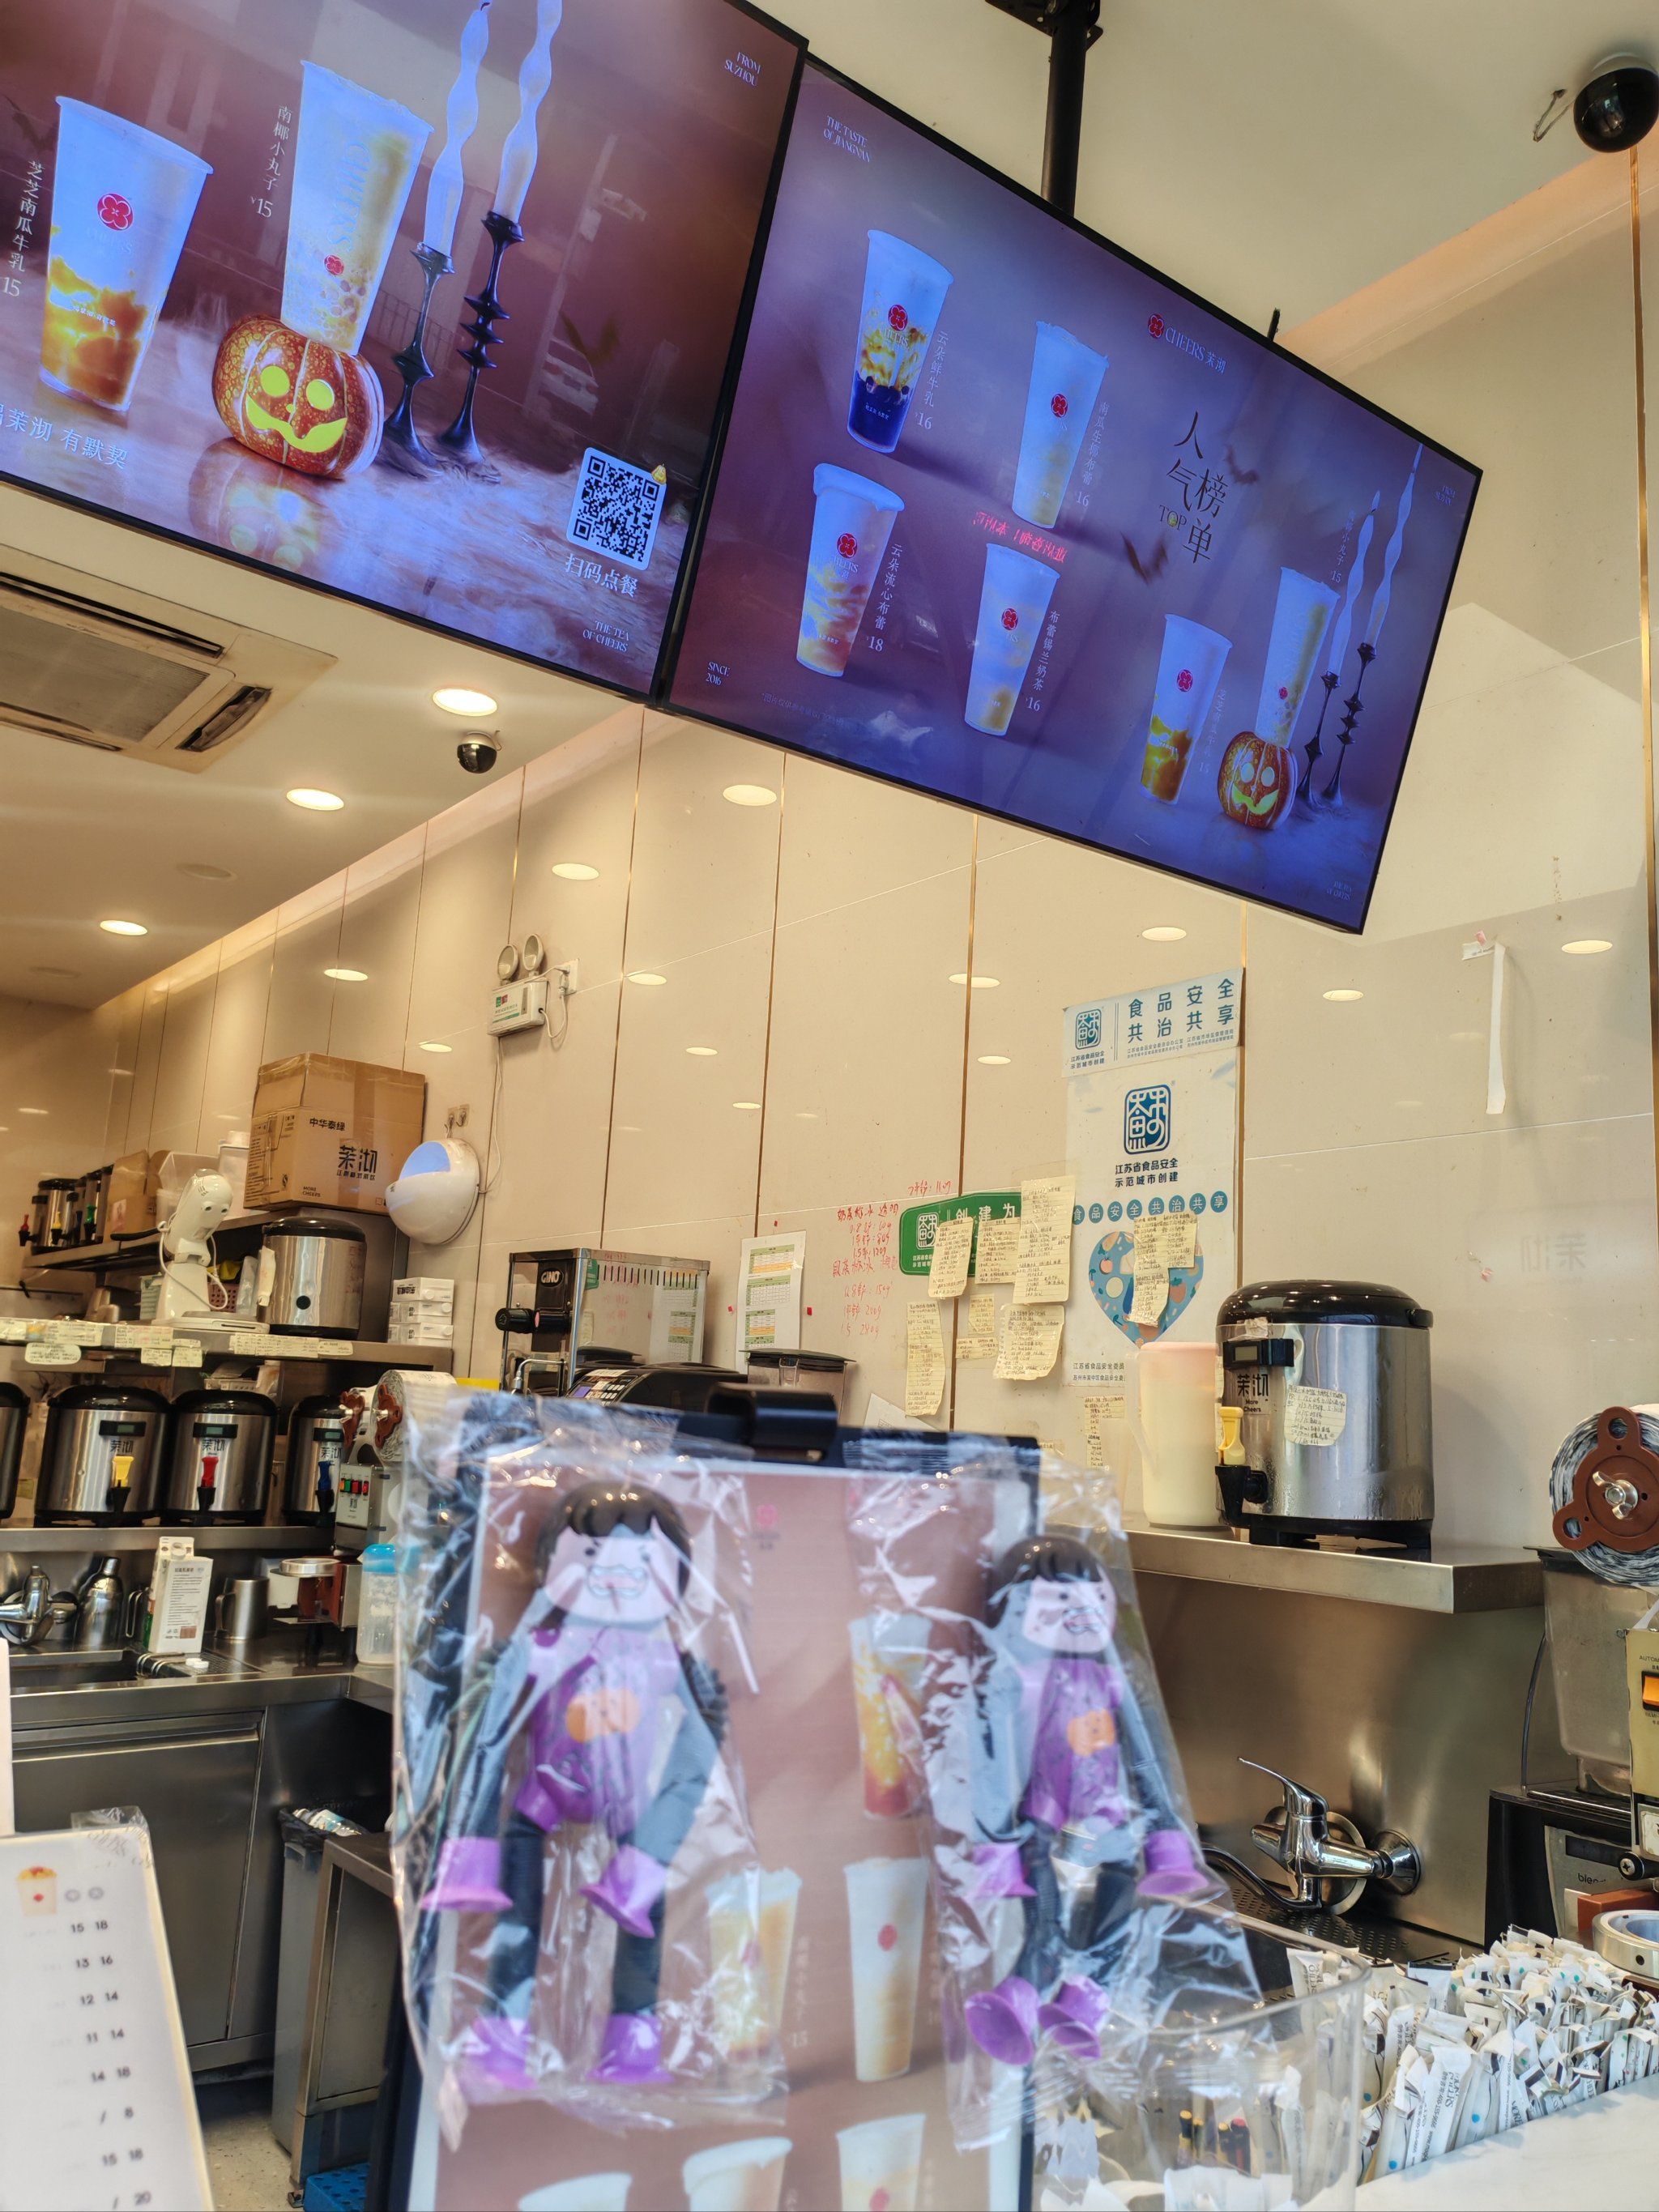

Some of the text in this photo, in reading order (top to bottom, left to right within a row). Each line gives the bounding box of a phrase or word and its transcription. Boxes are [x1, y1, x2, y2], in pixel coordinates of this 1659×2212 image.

[724, 59, 757, 87] SUZHOU
[736, 51, 761, 75] FROM
[262, 105, 292, 191] 南椰小丸子
[8, 160, 45, 272] 芝芝南瓜牛乳
[1165, 326, 1206, 362] CHEERS
[924, 330, 949, 407] 云朵鲜牛乳
[60, 428, 128, 470] 有默契
[1159, 505, 1188, 531] TOP
[565, 553, 638, 598] 扫码点餐
[875, 543, 903, 631] 云朵流心布蕾
[595, 620, 629, 641] THE TEA
[596, 633, 628, 652] CHEERS
[1032, 609, 1060, 691] 布蕾锡兰奶茶
[705, 672, 722, 686] 2016
[706, 661, 730, 677] SINCE
[1128, 978, 1235, 1019] 食品安全
[1127, 1004, 1235, 1044] 共治共享
[1115, 1157, 1179, 1175] 江苏省食品安全
[1115, 1171, 1179, 1188] 示范城市创建
[540, 1270, 560, 1284] GINO
[70, 1923, 85, 1933] 15
[75, 1954, 113, 1969] 13 16
[80, 1991, 119, 2005] 12 14
[86, 2029, 125, 2044] 11 14
[91, 2071, 105, 2082] 14
